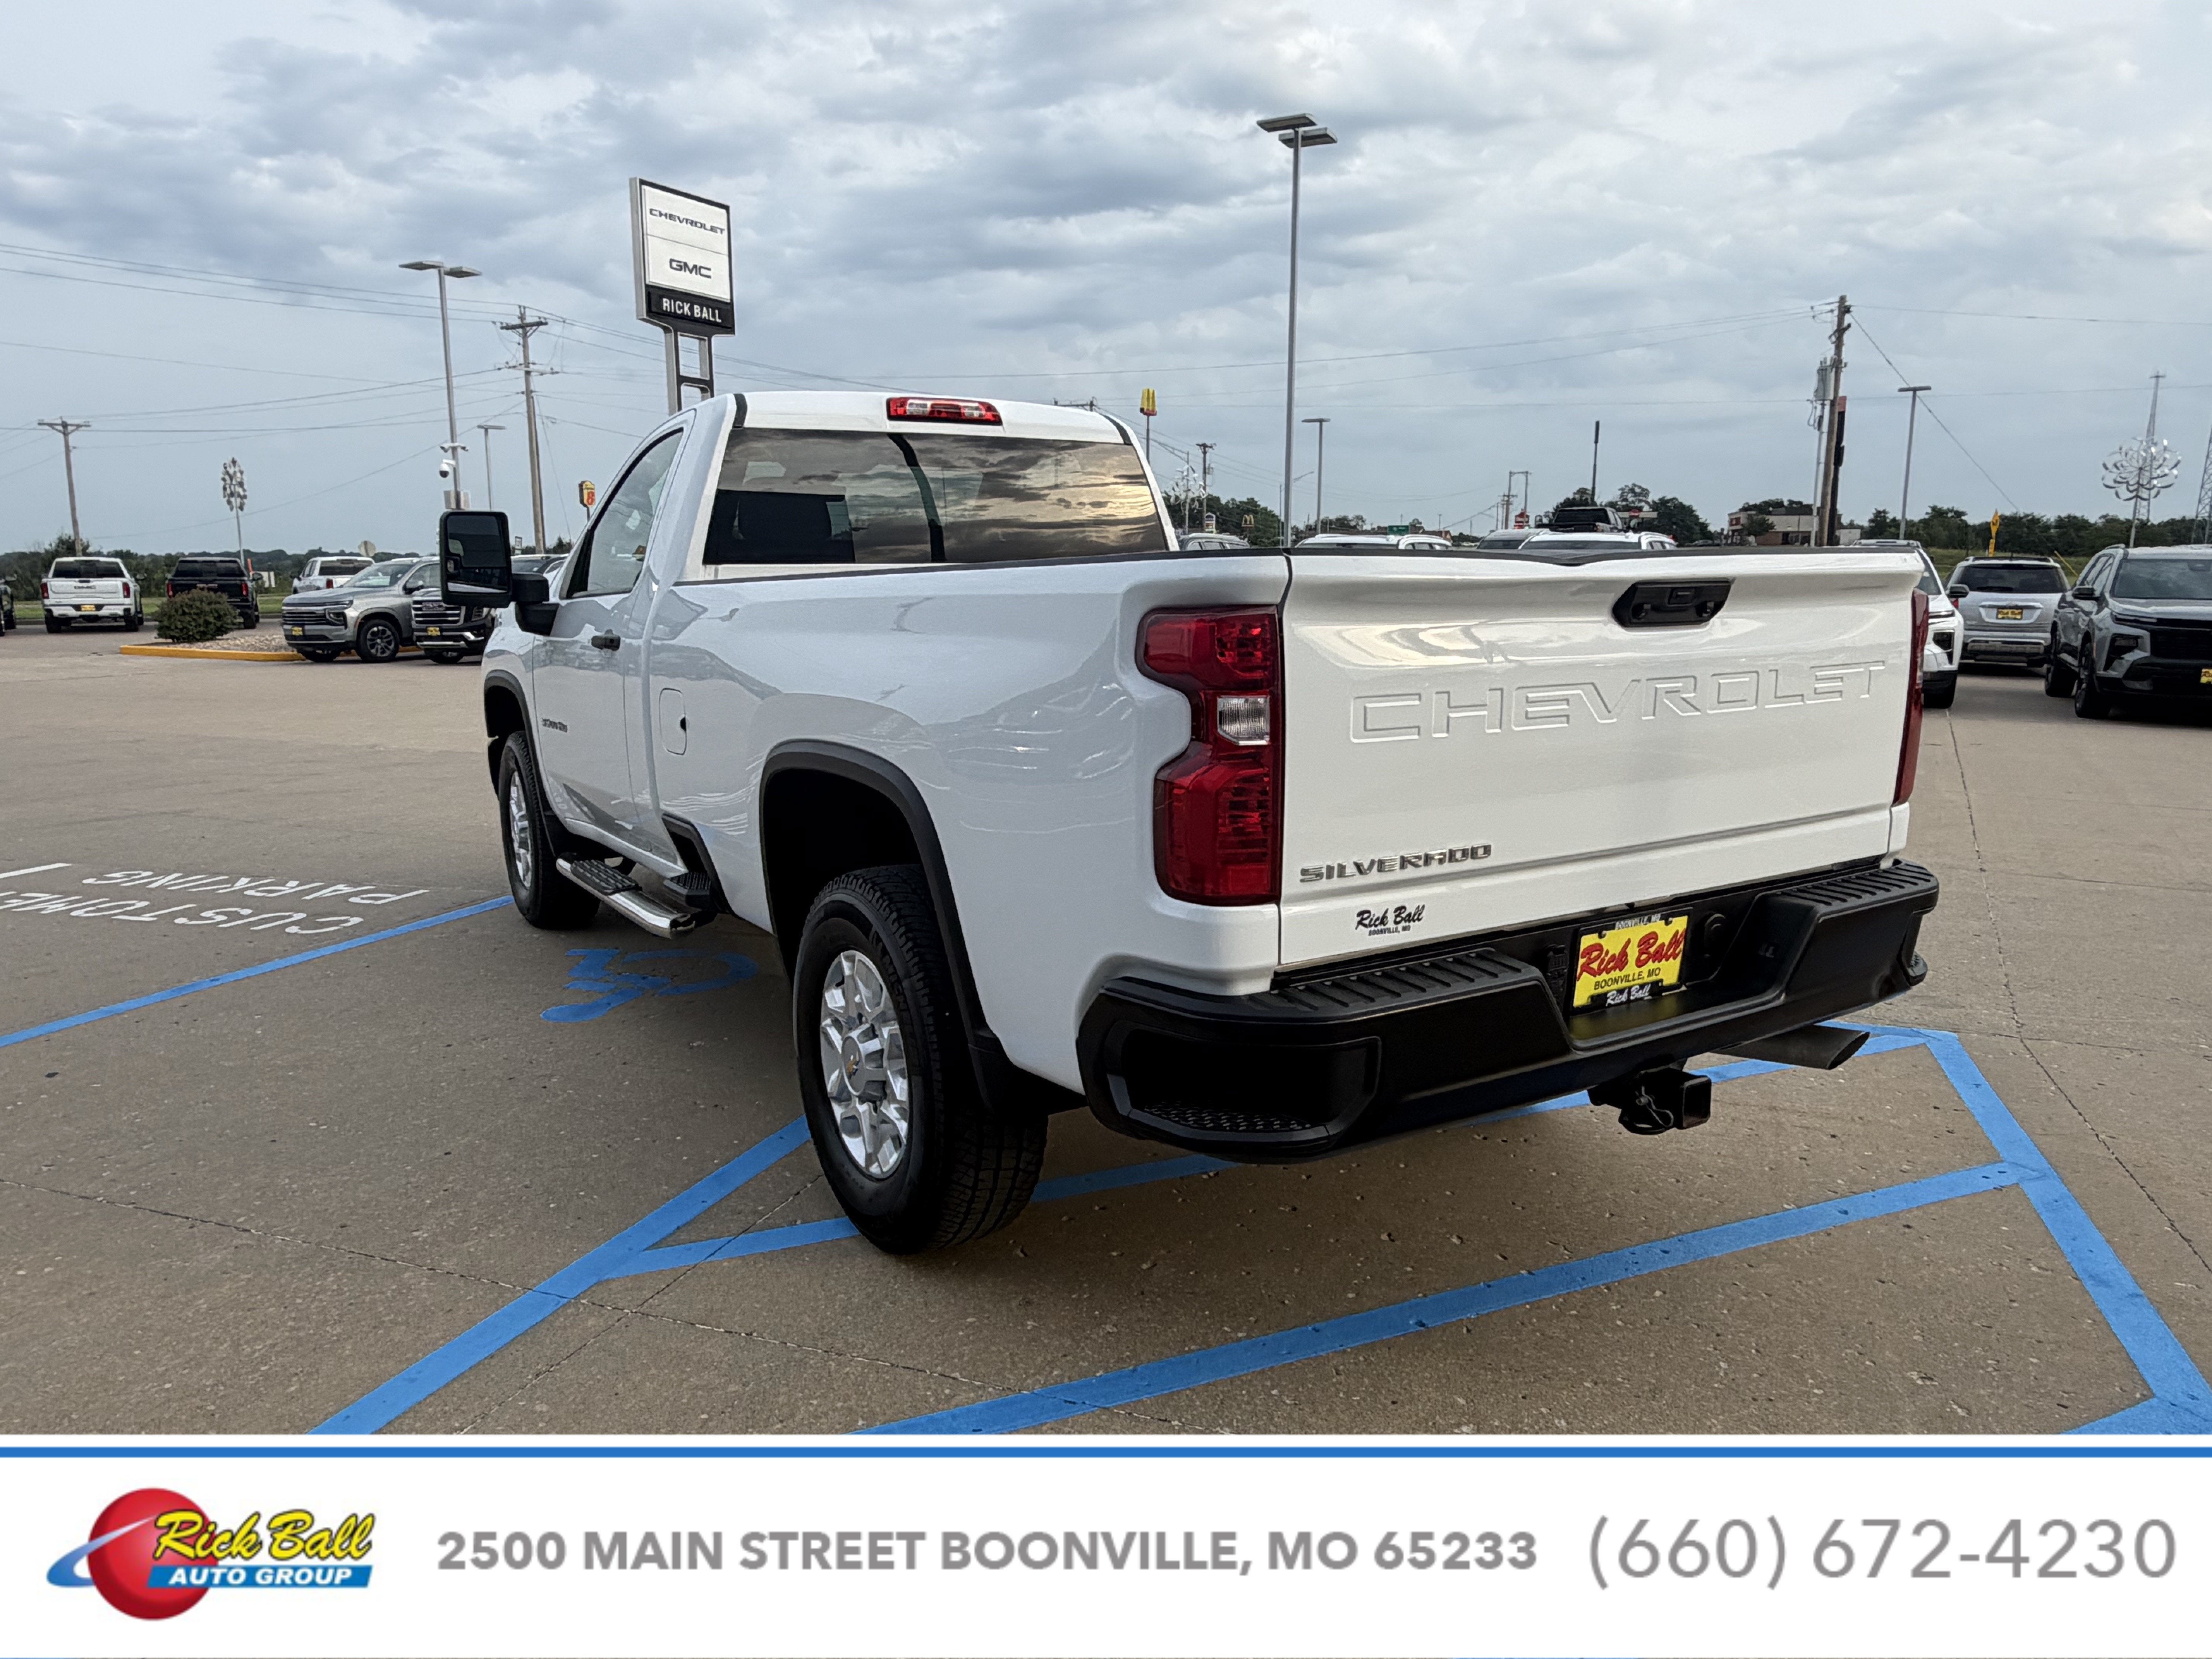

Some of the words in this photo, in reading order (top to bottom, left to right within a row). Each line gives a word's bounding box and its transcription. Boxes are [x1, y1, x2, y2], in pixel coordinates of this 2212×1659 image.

[649, 208, 726, 235] CHEVROLET
[669, 258, 712, 279] GMC
[663, 297, 690, 316] RICK
[694, 304, 722, 323] BALL
[1350, 660, 1885, 743] CHEVROLET
[1299, 843, 1492, 883] SILVERADO
[82, 870, 429, 905] PARKING
[0, 891, 364, 934] CUSTOME
[1355, 908, 1389, 930] Rick
[1393, 904, 1425, 925] Ball
[1577, 938, 1631, 981] Rick
[1635, 928, 1686, 968] Ball
[1594, 972, 1645, 990] BOONVILLE,
[1647, 967, 1661, 982] MO
[1606, 987, 1628, 1006] Rick
[1630, 984, 1651, 1000] Ball
